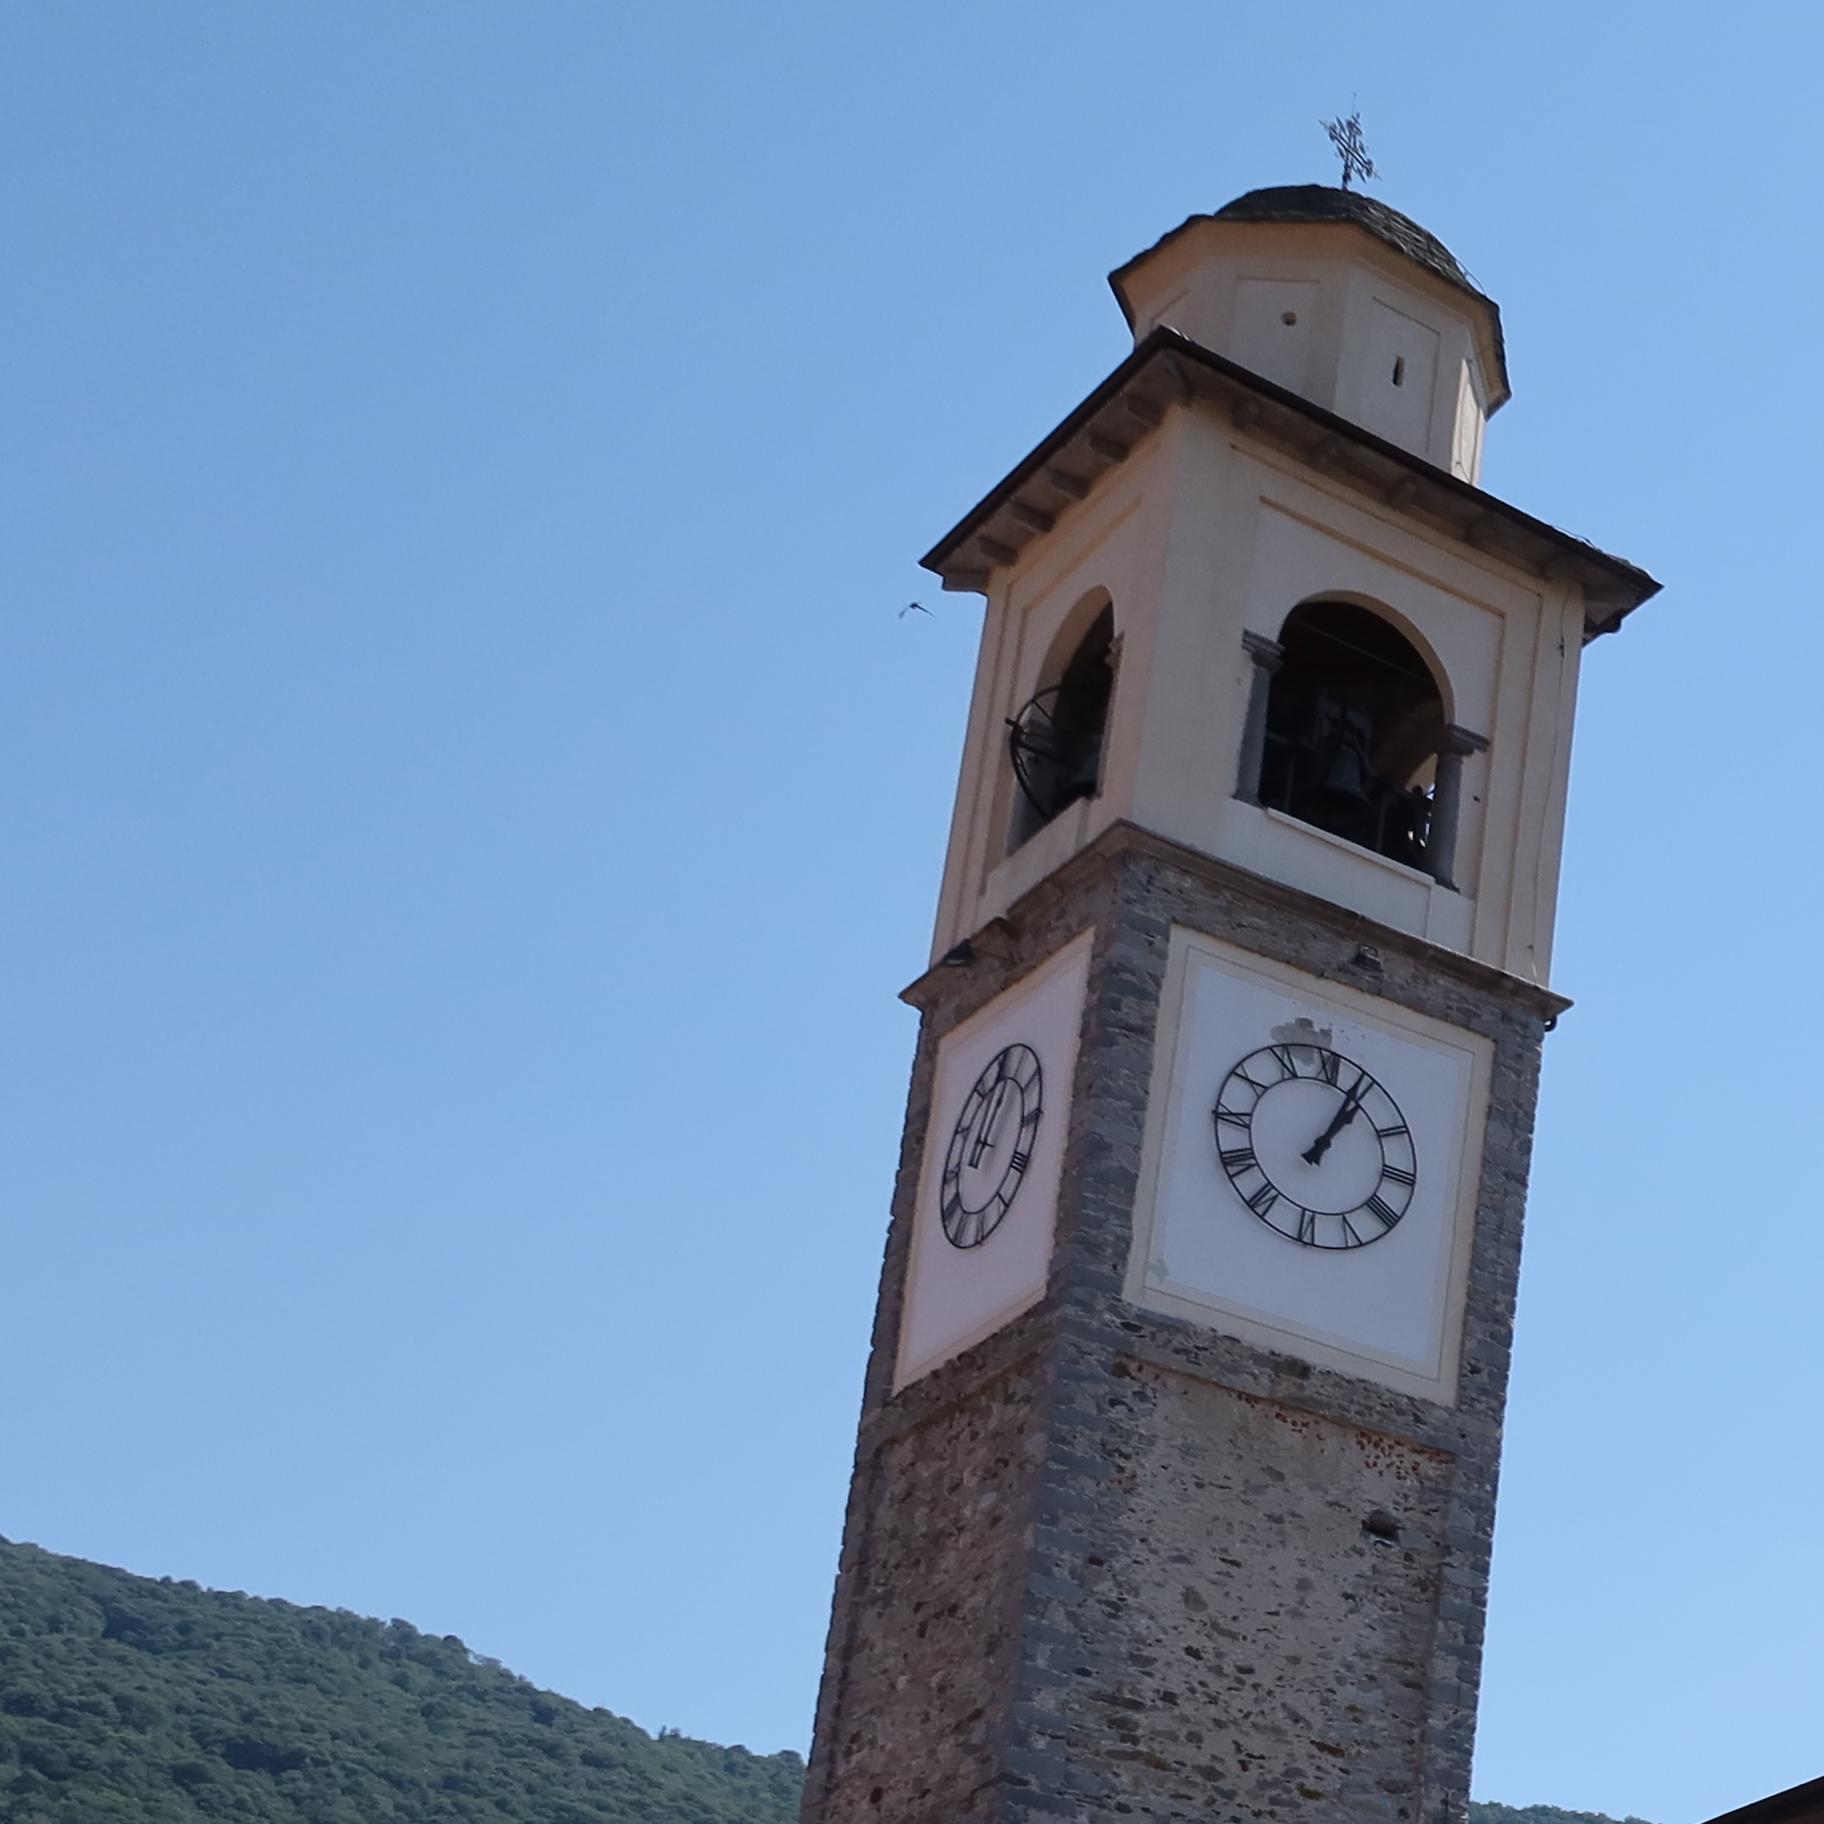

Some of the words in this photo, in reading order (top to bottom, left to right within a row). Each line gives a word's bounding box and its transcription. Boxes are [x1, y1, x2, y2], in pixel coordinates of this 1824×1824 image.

[1377, 1124, 1409, 1138] II
[1382, 1163, 1417, 1187] III
[1341, 1213, 1364, 1248] V
